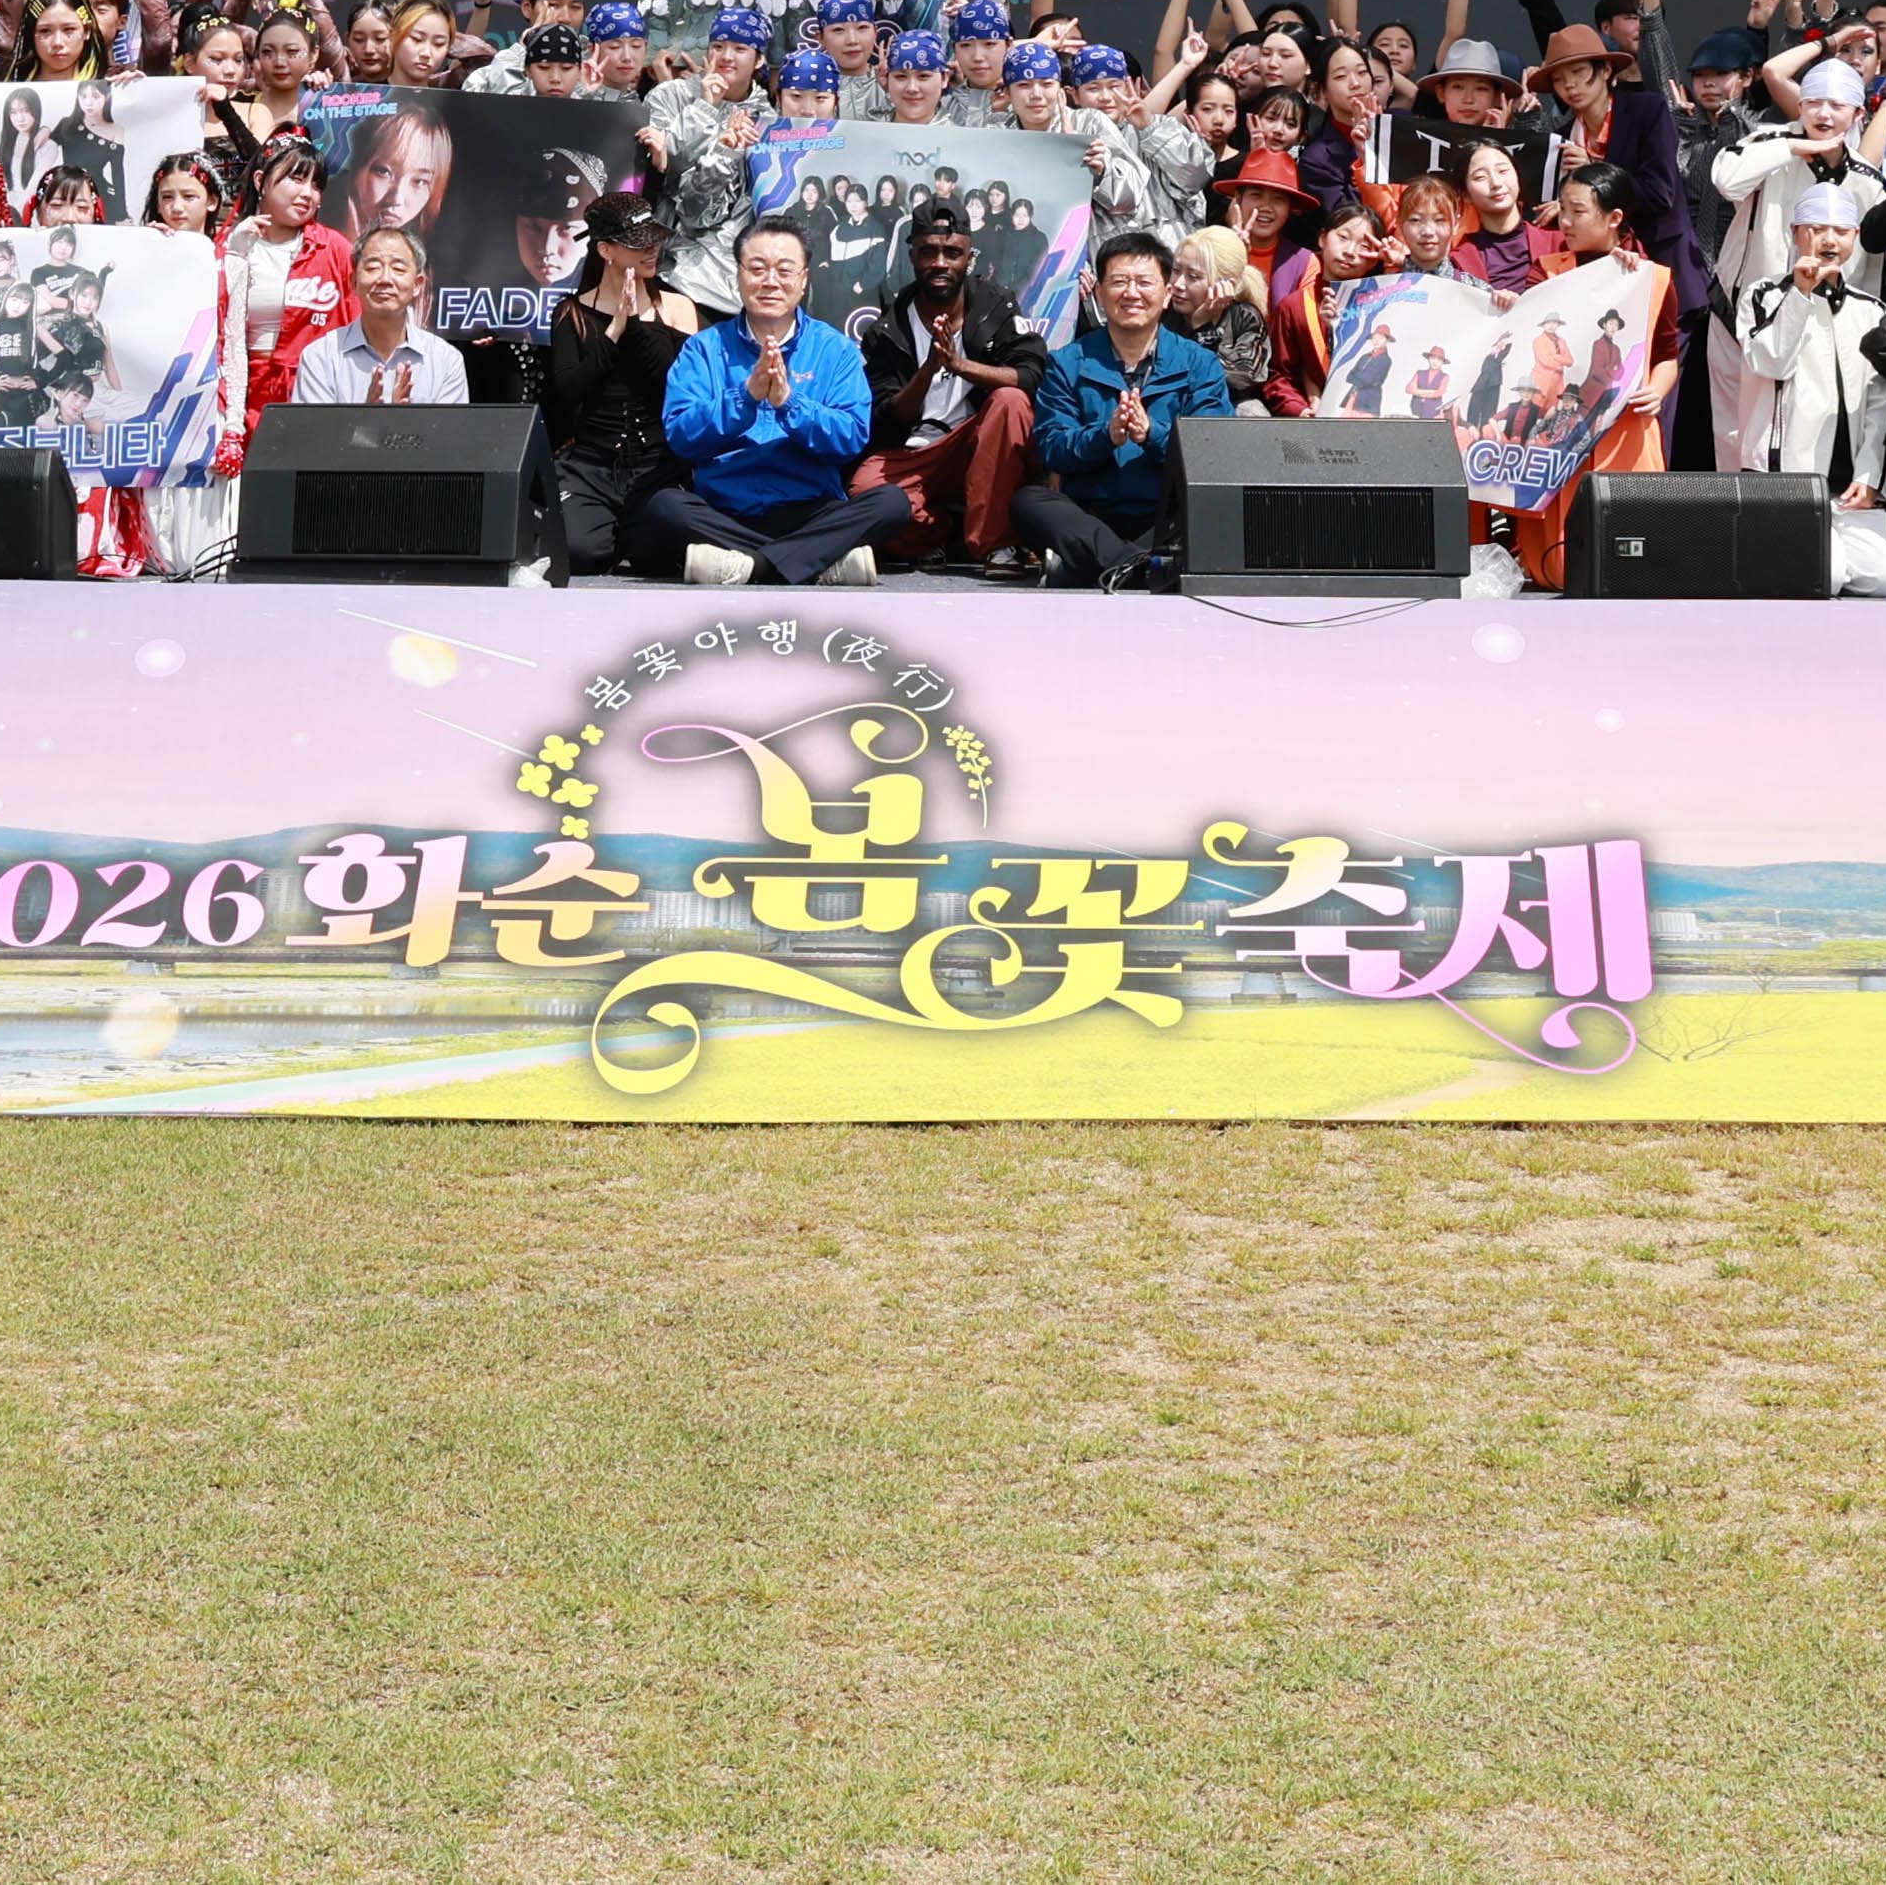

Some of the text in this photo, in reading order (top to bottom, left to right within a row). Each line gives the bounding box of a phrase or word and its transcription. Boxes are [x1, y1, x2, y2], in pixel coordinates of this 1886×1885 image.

[303, 102, 398, 120] ON THE STAGE
[802, 137, 845, 150] STAGE
[1466, 439, 1579, 490] CREW
[284, 832, 651, 968] 화순
[592, 702, 1205, 1095] 봄꽃
[1202, 821, 1656, 1075] 축제
